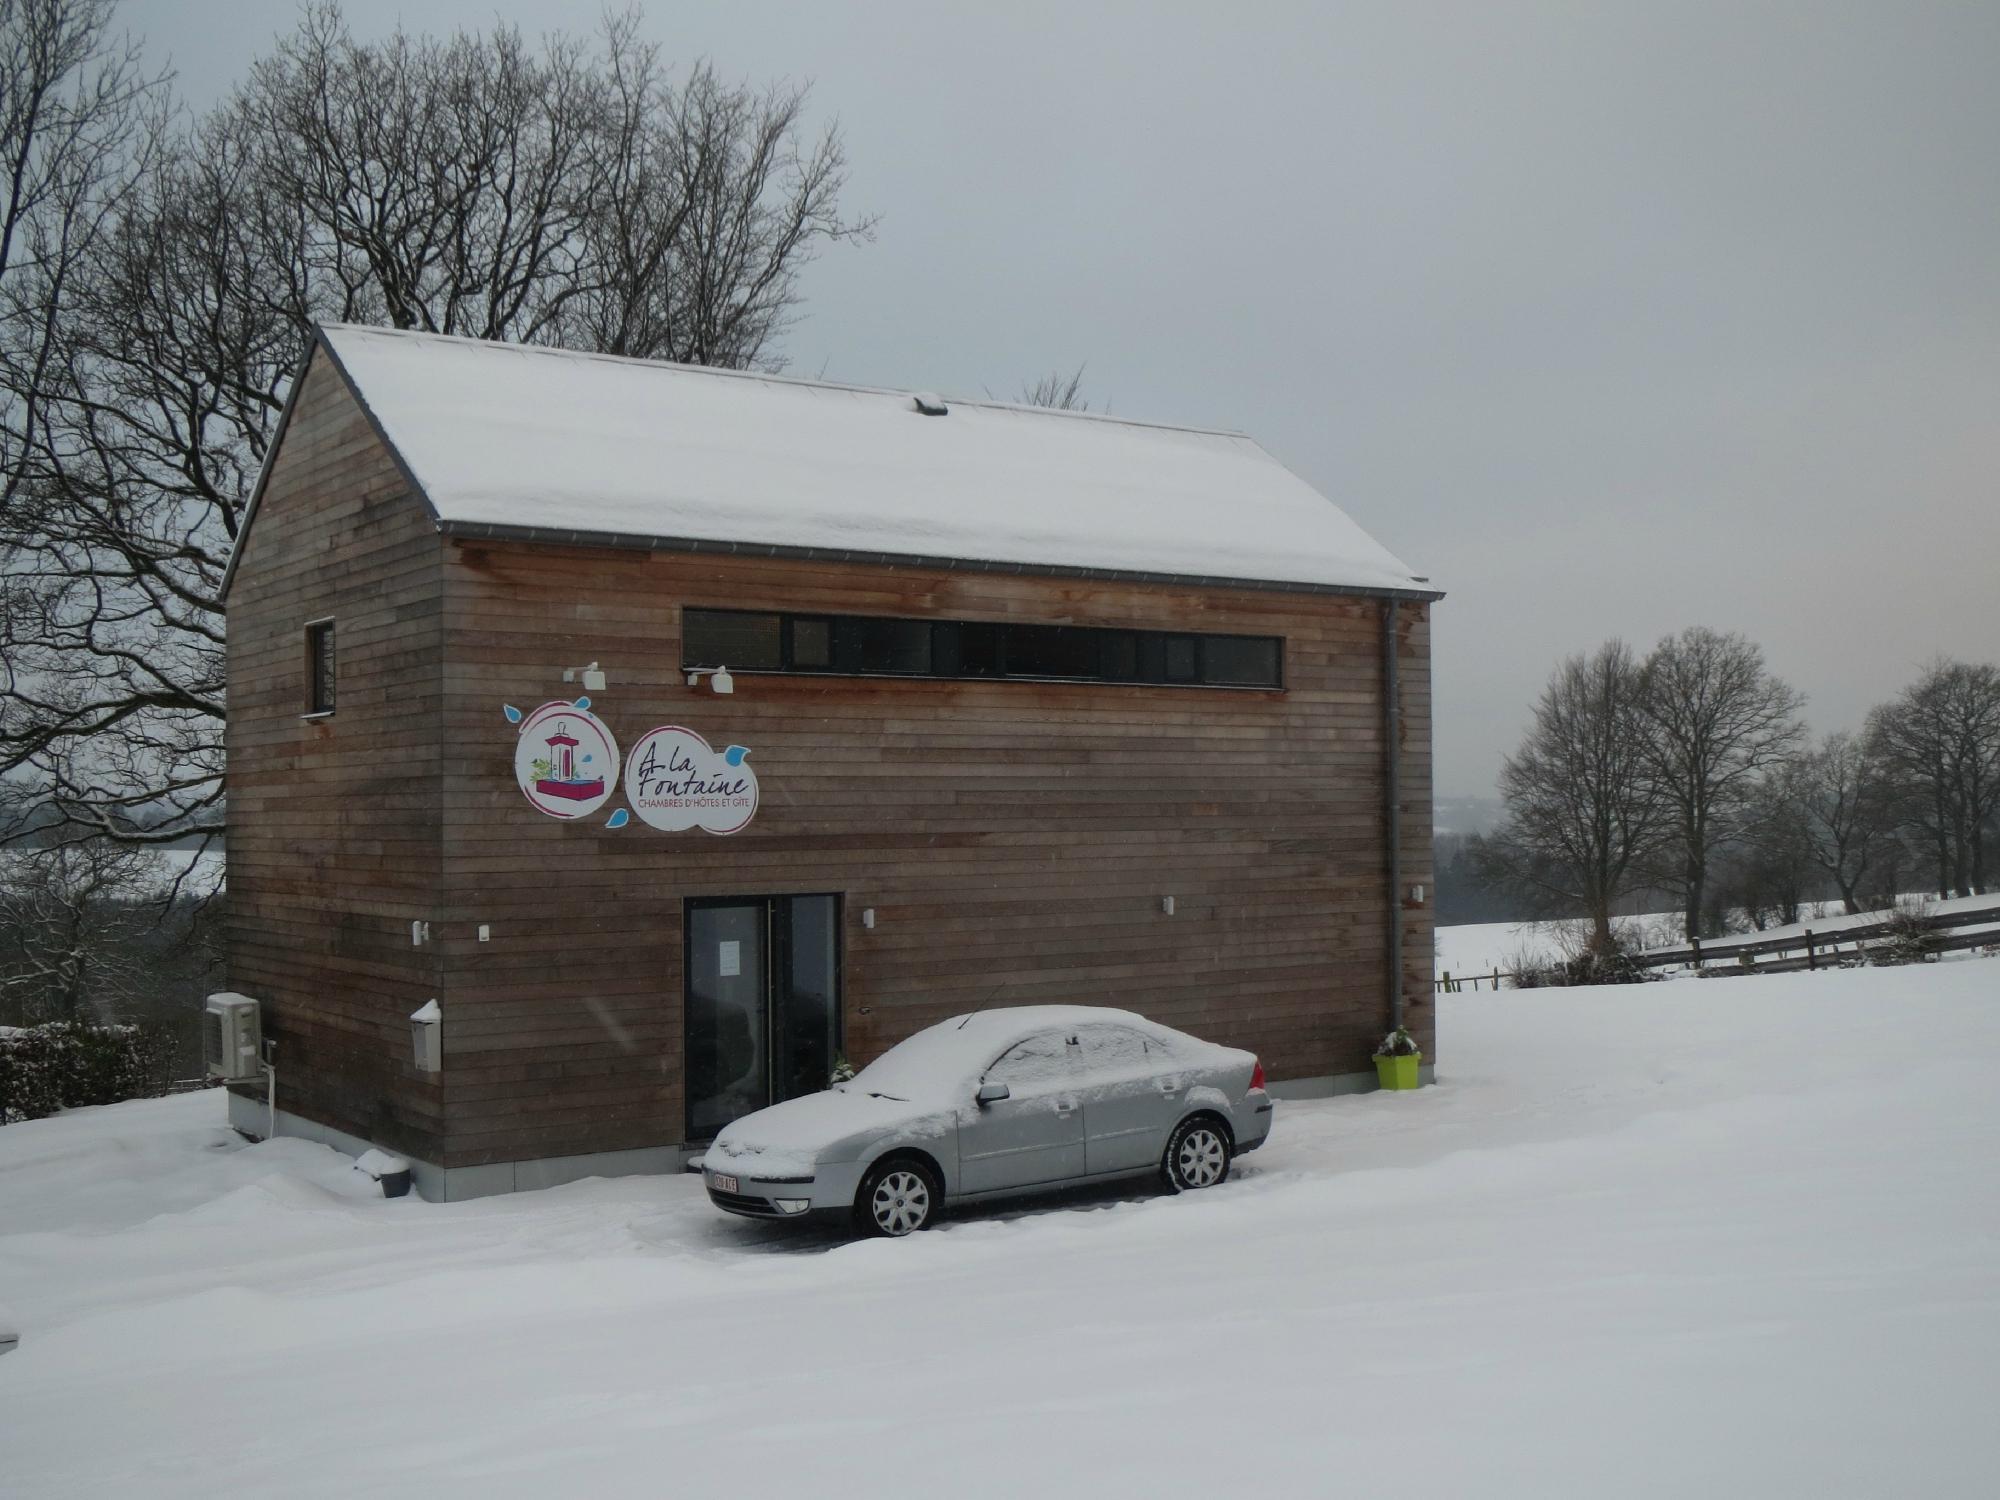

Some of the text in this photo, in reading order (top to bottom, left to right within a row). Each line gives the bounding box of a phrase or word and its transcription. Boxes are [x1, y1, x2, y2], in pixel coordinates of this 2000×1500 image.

[639, 741, 696, 774] A la
[638, 770, 750, 797] Fontaine
[638, 799, 683, 808] CHAMBRES
[685, 797, 720, 808] D'HÔTES
[721, 799, 731, 807] ET
